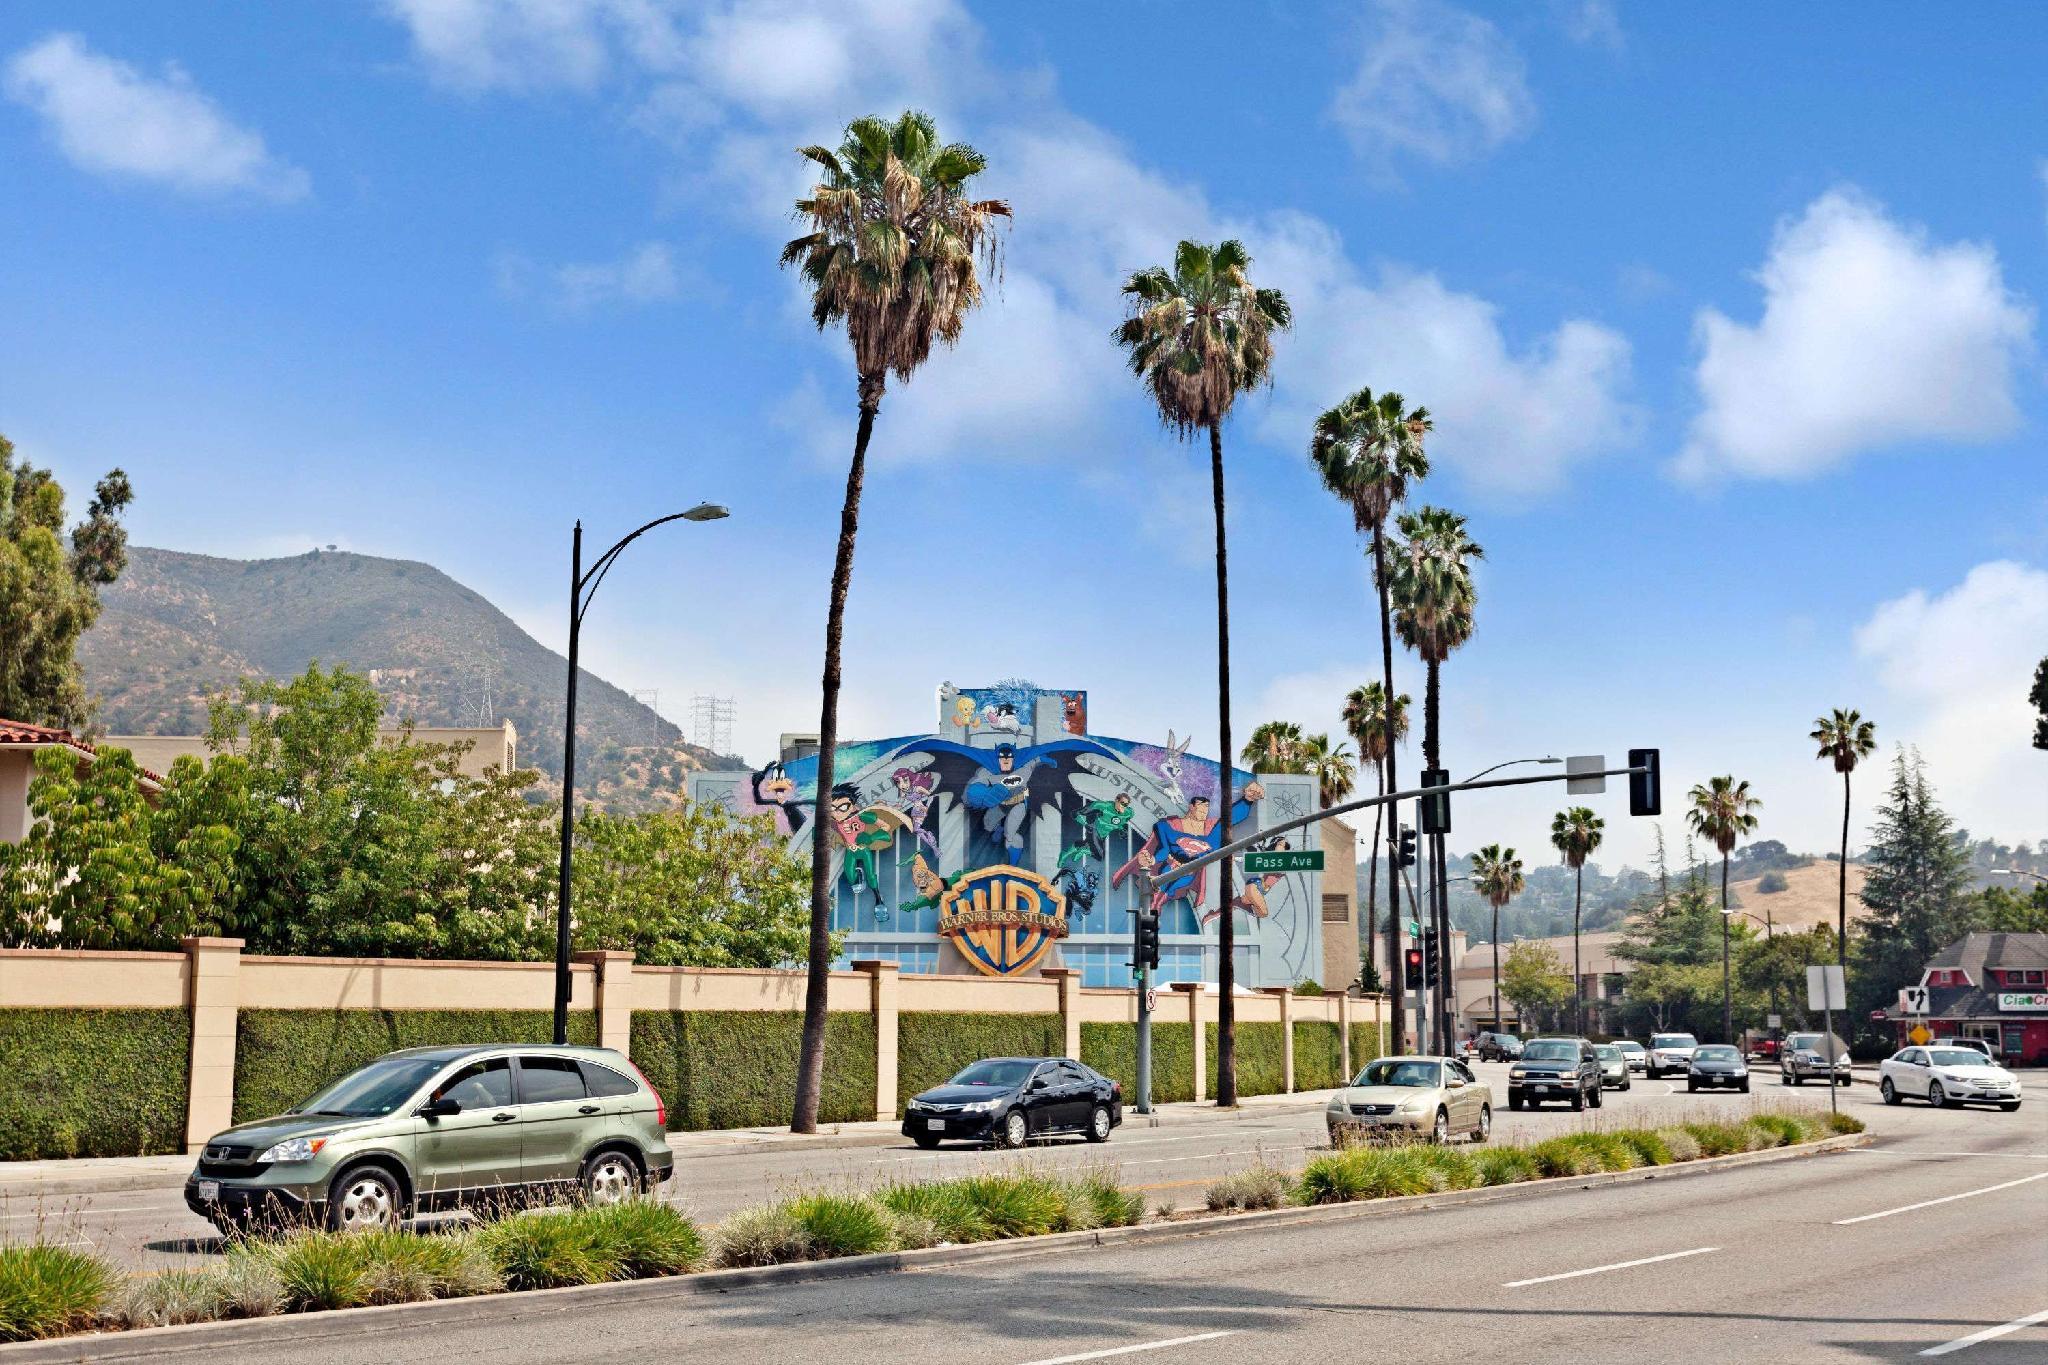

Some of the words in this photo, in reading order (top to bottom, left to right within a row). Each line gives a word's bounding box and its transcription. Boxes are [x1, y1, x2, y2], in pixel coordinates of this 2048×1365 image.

[1086, 759, 1168, 820] JUSTICE
[1255, 856, 1284, 868] Pass
[1290, 855, 1313, 867] Ave
[940, 911, 989, 930] WARNER
[991, 911, 1020, 923] BROS.
[1021, 911, 1067, 931] STUDIOS
